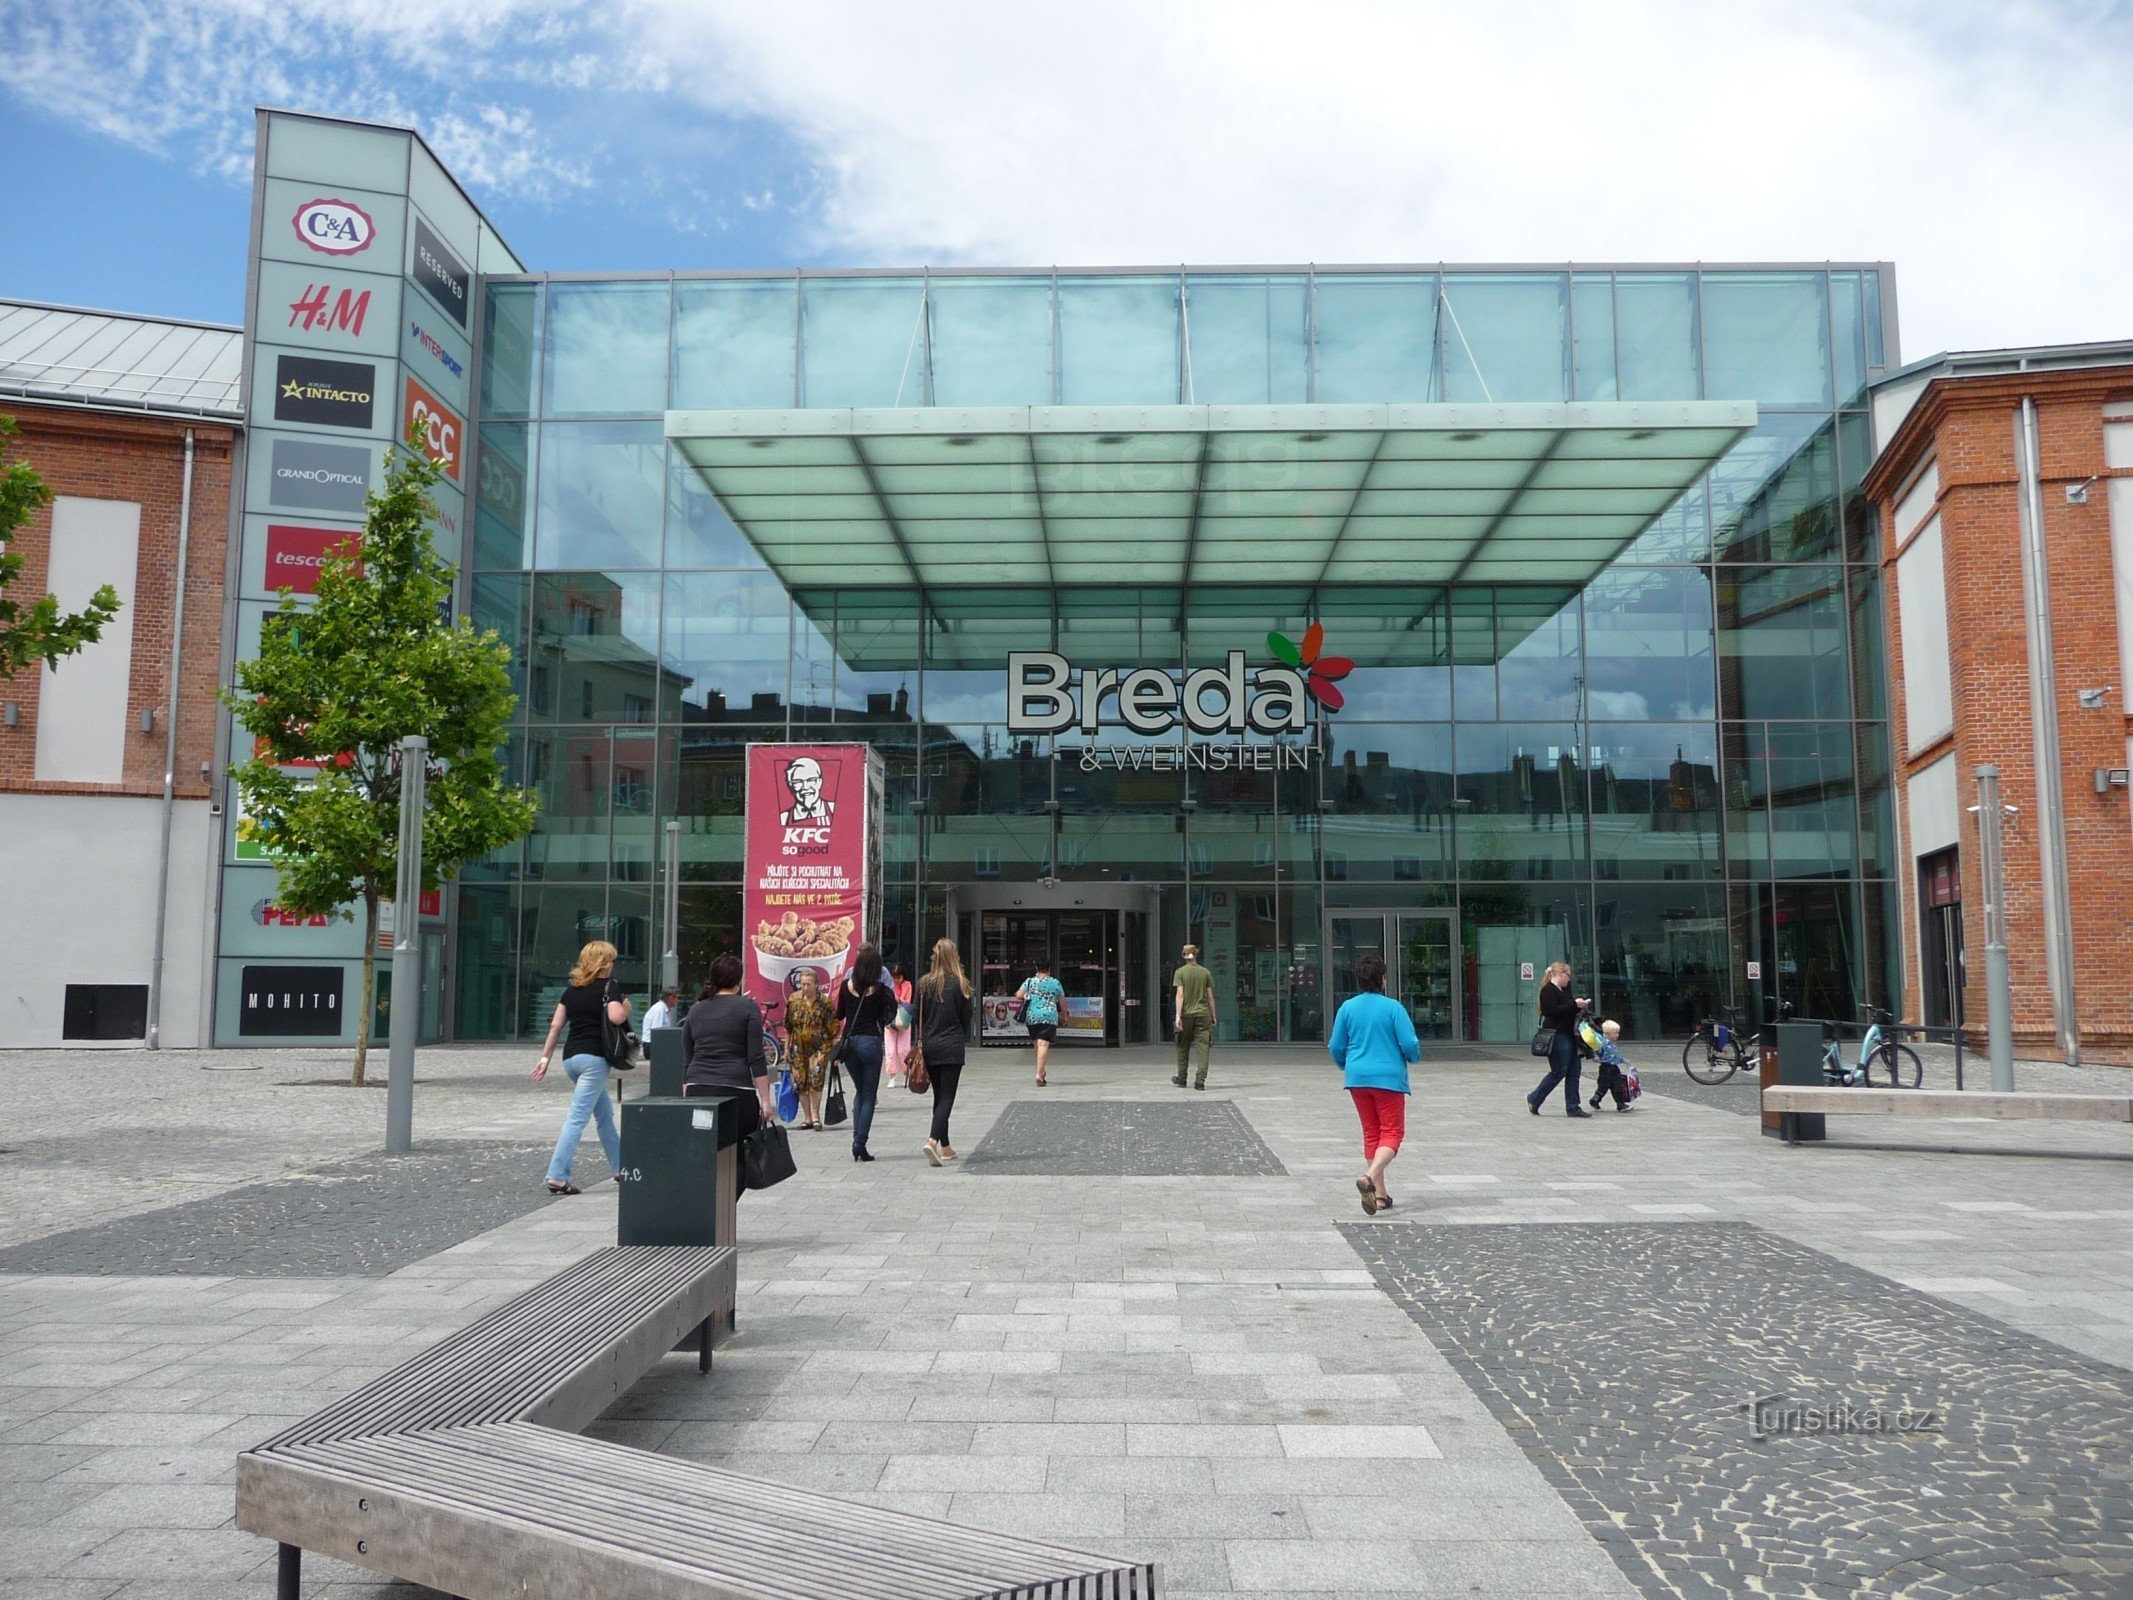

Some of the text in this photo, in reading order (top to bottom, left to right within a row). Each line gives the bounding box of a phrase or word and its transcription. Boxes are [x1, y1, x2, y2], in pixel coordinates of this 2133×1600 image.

[307, 212, 360, 242] C&A
[420, 246, 463, 300] RESERVED
[288, 284, 371, 337] H&M
[420, 329, 462, 379] INTERSPORT
[306, 388, 370, 403] INTACTO
[1007, 650, 1306, 735] Breda
[1079, 744, 1308, 772] & WEINSTEIN
[782, 828, 831, 843] KFC
[791, 866, 797, 877] SI
[798, 866, 832, 877] POCHUTNAT
[833, 866, 843, 877] NA
[793, 892, 805, 905] NÁS
[807, 894, 815, 905] VE
[249, 993, 335, 1009] MOHITO
